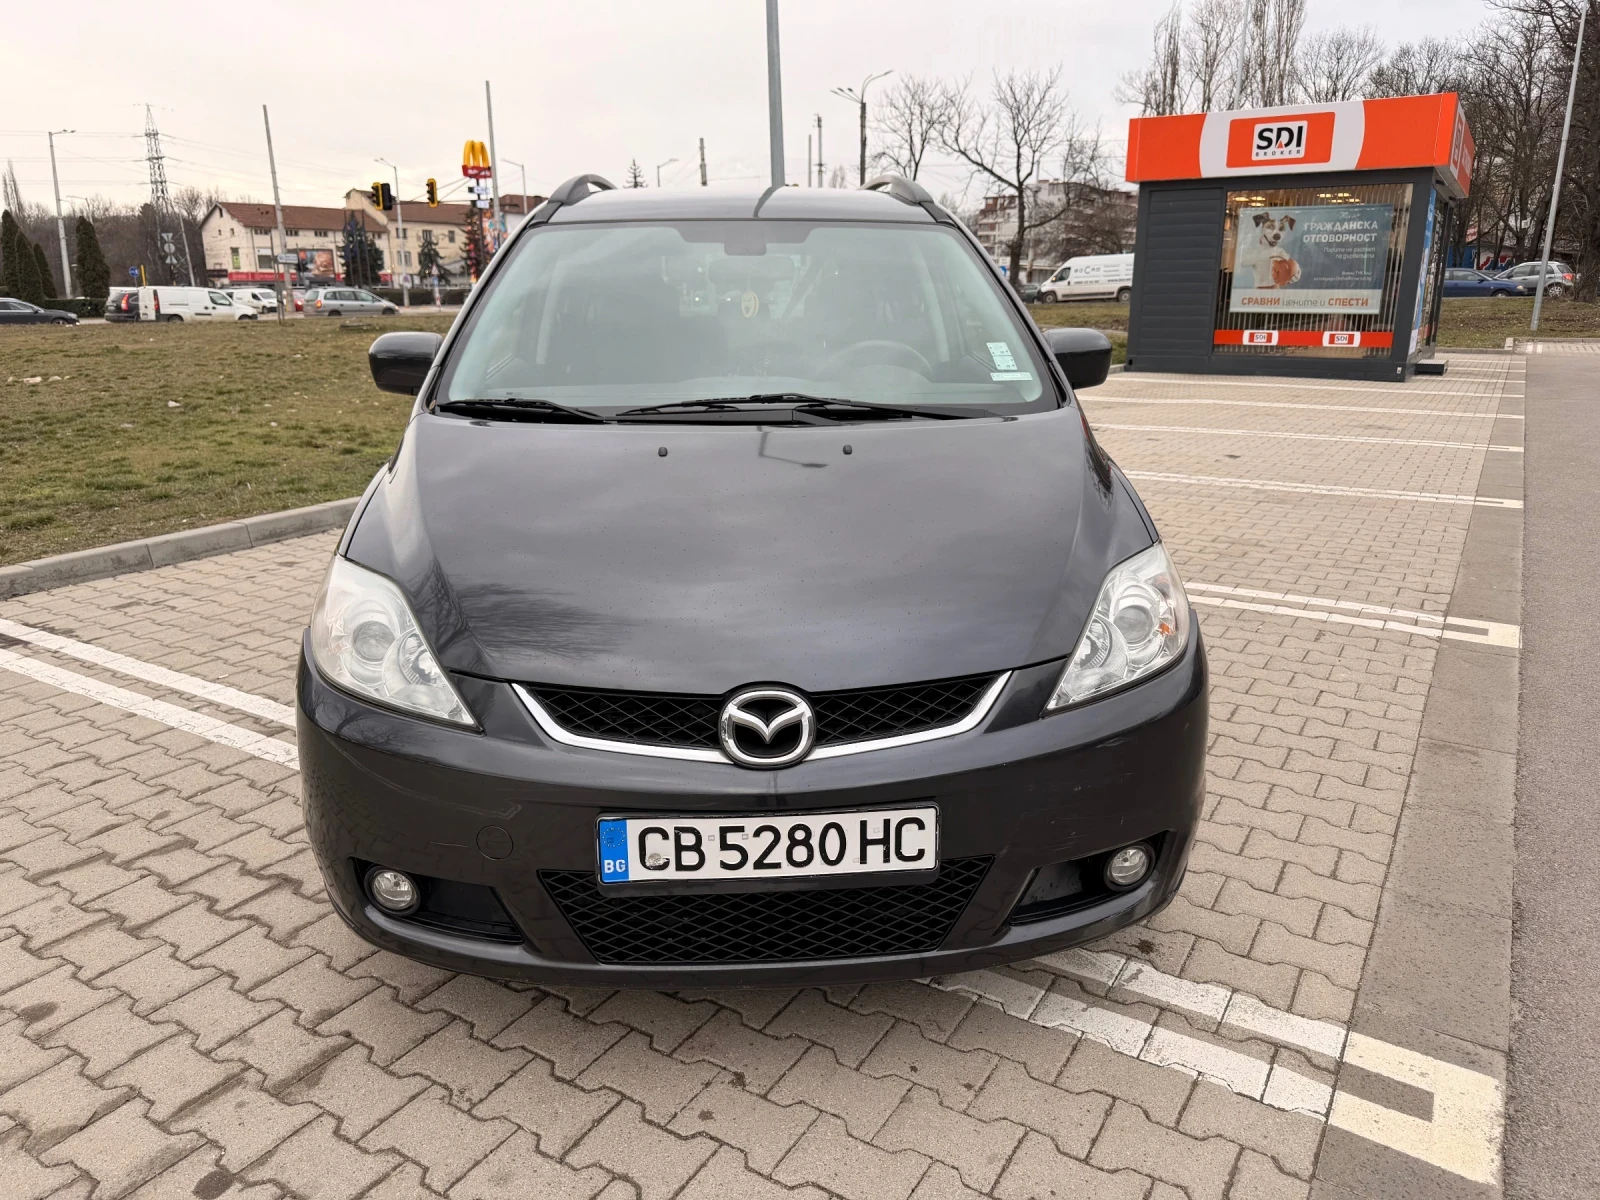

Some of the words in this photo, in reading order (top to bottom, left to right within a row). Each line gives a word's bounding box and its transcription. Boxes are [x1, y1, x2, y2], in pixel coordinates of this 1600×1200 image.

[1256, 126, 1303, 150] SDI
[1255, 149, 1301, 157] BROKER
[1303, 221, 1378, 231] ГРАЖДАНСКА
[1303, 233, 1378, 243] ОТГОВОРНОСТ
[1241, 297, 1281, 306] СРАВНИ
[1282, 297, 1318, 308] цените
[1319, 298, 1326, 306] и
[1328, 298, 1369, 306] СПЕСТИ
[638, 825, 706, 873] CB
[719, 820, 847, 871] 5280
[858, 816, 927, 866] HC
[603, 859, 626, 874] BG
